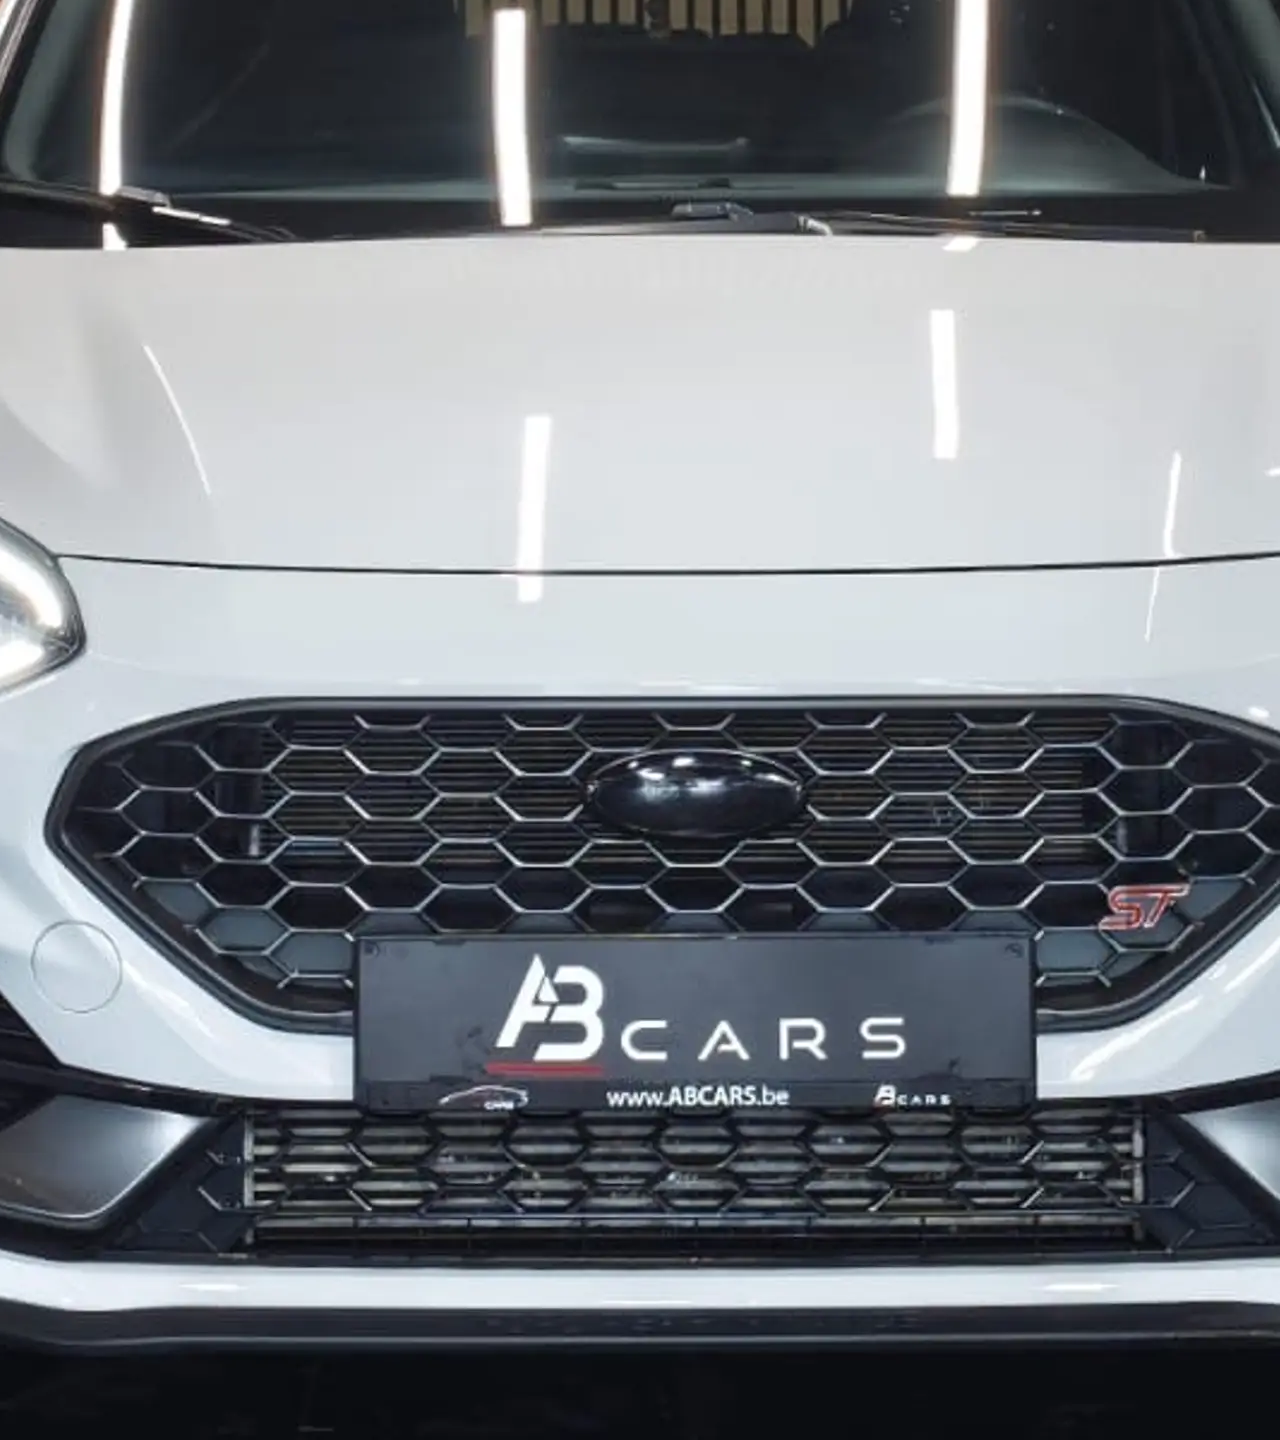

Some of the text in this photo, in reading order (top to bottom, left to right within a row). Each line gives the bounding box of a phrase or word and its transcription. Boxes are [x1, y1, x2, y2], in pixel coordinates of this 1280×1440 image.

[1098, 883, 1191, 931] ST
[495, 953, 907, 1062] AB CARS
[605, 1083, 791, 1108] www.ABCARS.be
